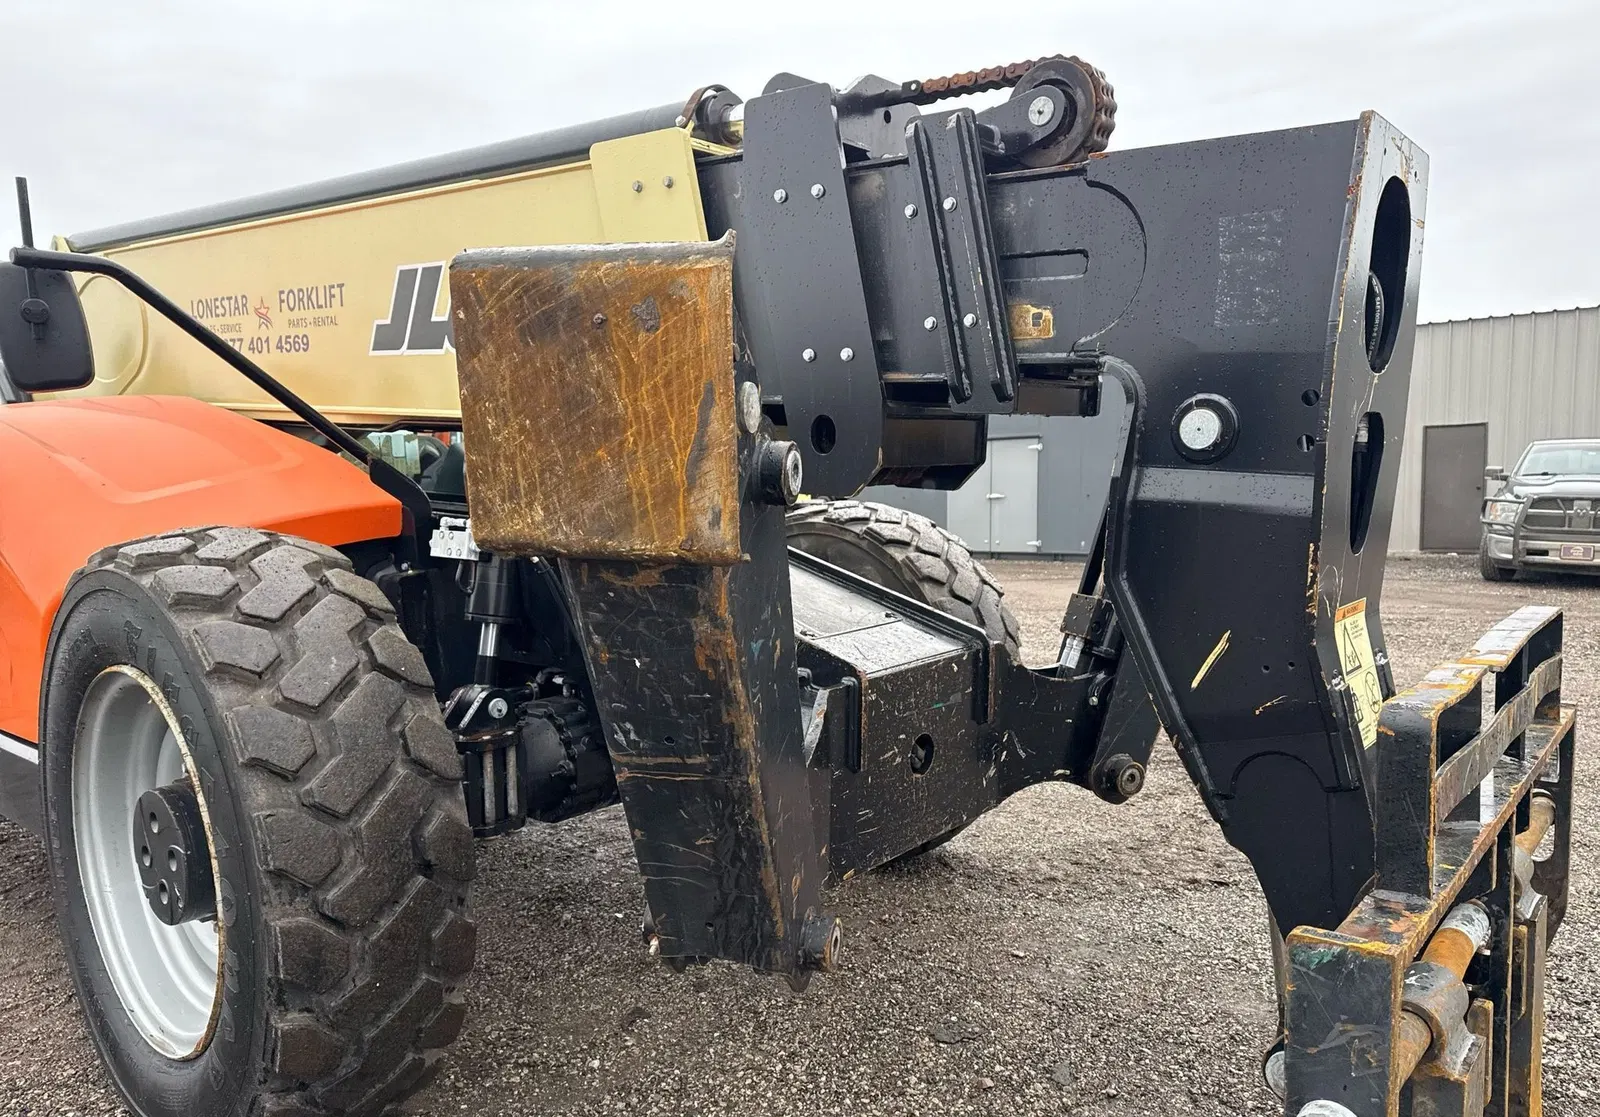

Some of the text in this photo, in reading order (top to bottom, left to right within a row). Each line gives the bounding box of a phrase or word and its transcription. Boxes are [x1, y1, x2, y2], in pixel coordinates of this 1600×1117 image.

[190, 283, 345, 319] LONESTAR FORKLIFT
[369, 261, 456, 355] JL
[220, 323, 242, 334] SERVICE
[288, 318, 308, 329] PARTS
[313, 315, 339, 327] RENTAL
[248, 336, 271, 354] 401
[276, 334, 310, 353] 4569
